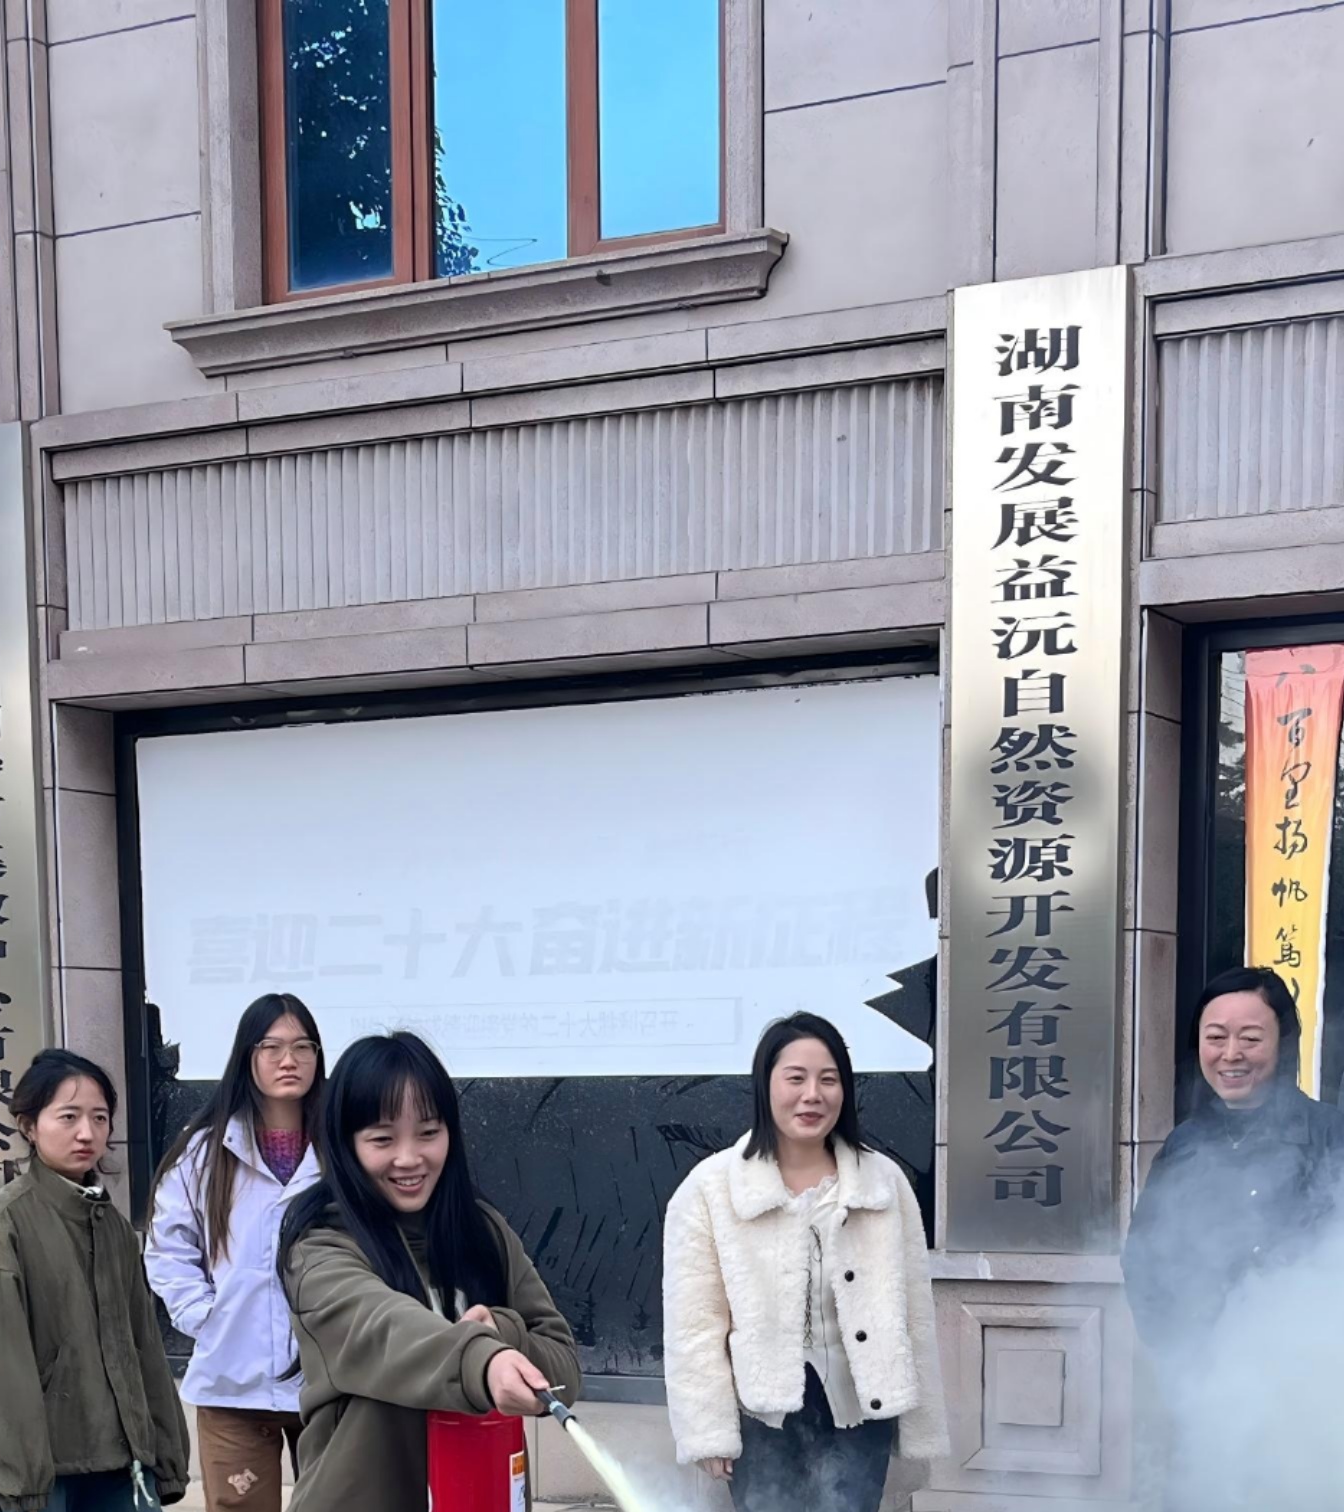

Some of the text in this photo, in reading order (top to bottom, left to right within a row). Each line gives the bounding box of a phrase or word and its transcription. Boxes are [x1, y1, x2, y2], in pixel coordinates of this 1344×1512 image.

[984, 324, 1080, 1208] 湖南发展益沅自然资源开发有限公司
